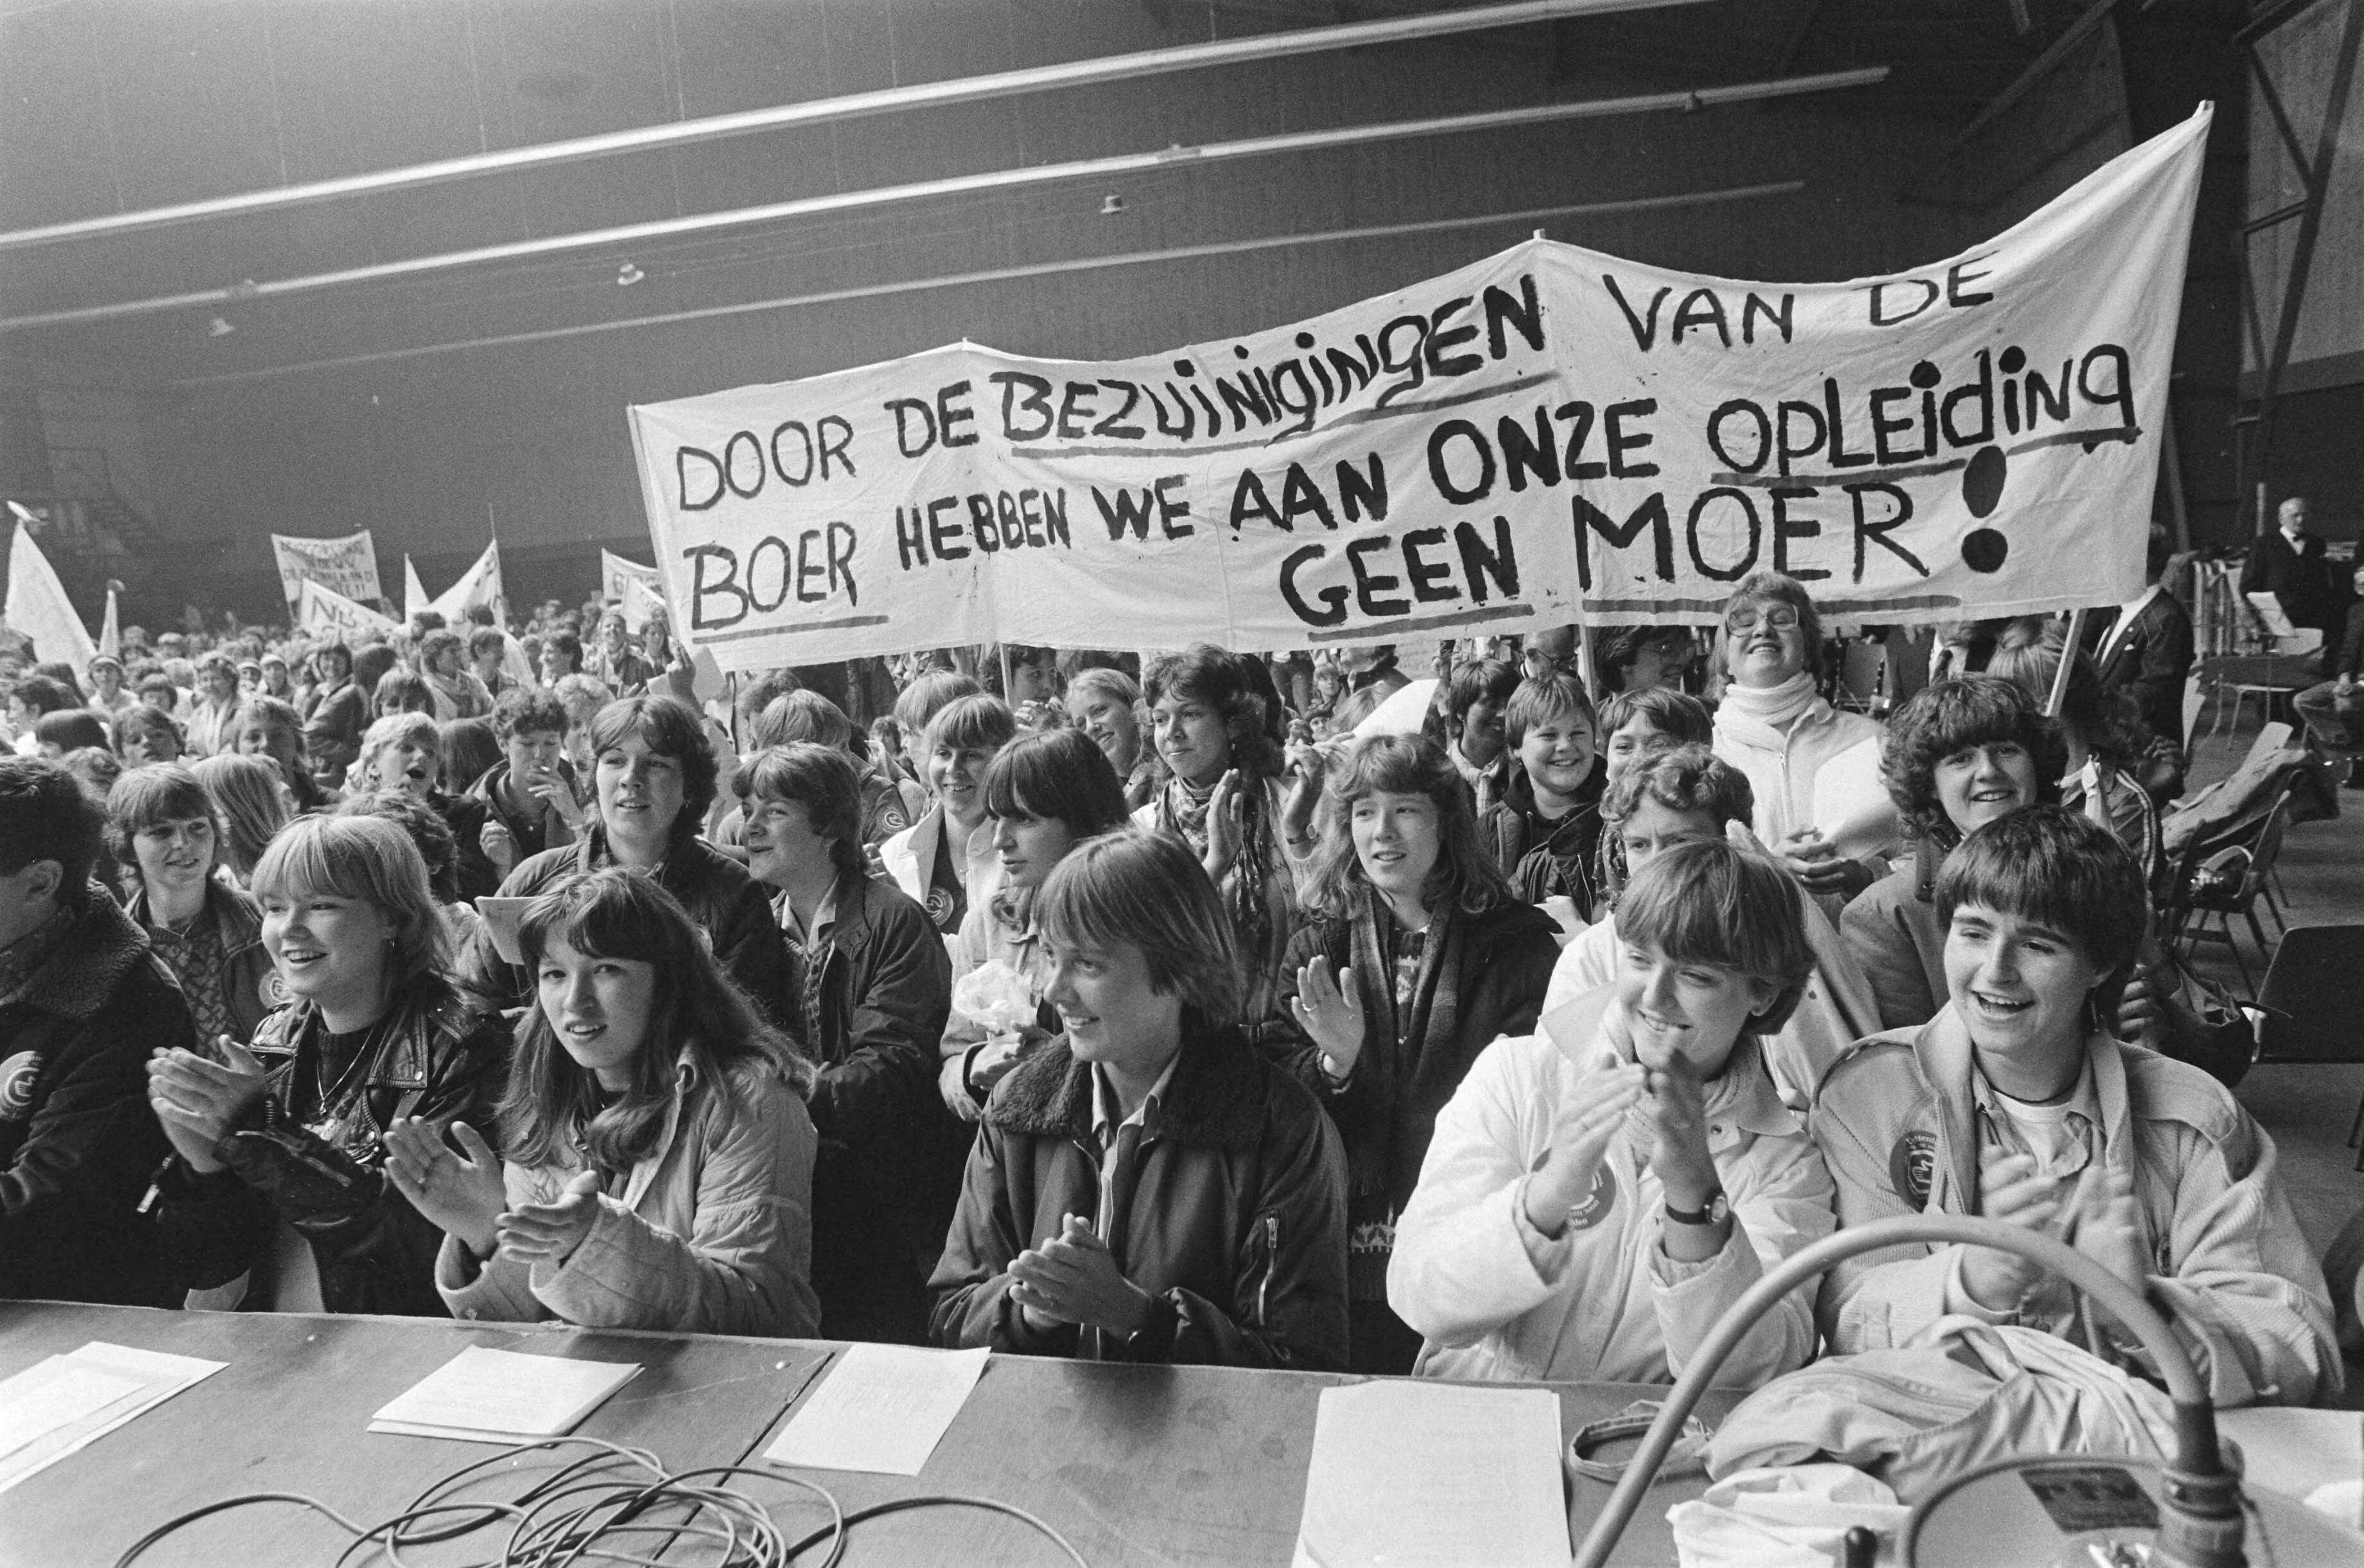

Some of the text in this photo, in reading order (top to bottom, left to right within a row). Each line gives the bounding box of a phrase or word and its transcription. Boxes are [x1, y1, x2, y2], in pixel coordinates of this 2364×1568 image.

[676, 415, 856, 512] DOOR
[883, 380, 980, 458] DE
[1603, 274, 1796, 352] VAN
[1852, 251, 1999, 326] DE
[683, 521, 858, 630] BOER
[896, 488, 1071, 571] HEBBEN
[1091, 475, 1195, 541] WE
[1230, 451, 1389, 532] AAN
[1427, 397, 1660, 506] ONZE
[1279, 515, 1520, 627] GEEN
